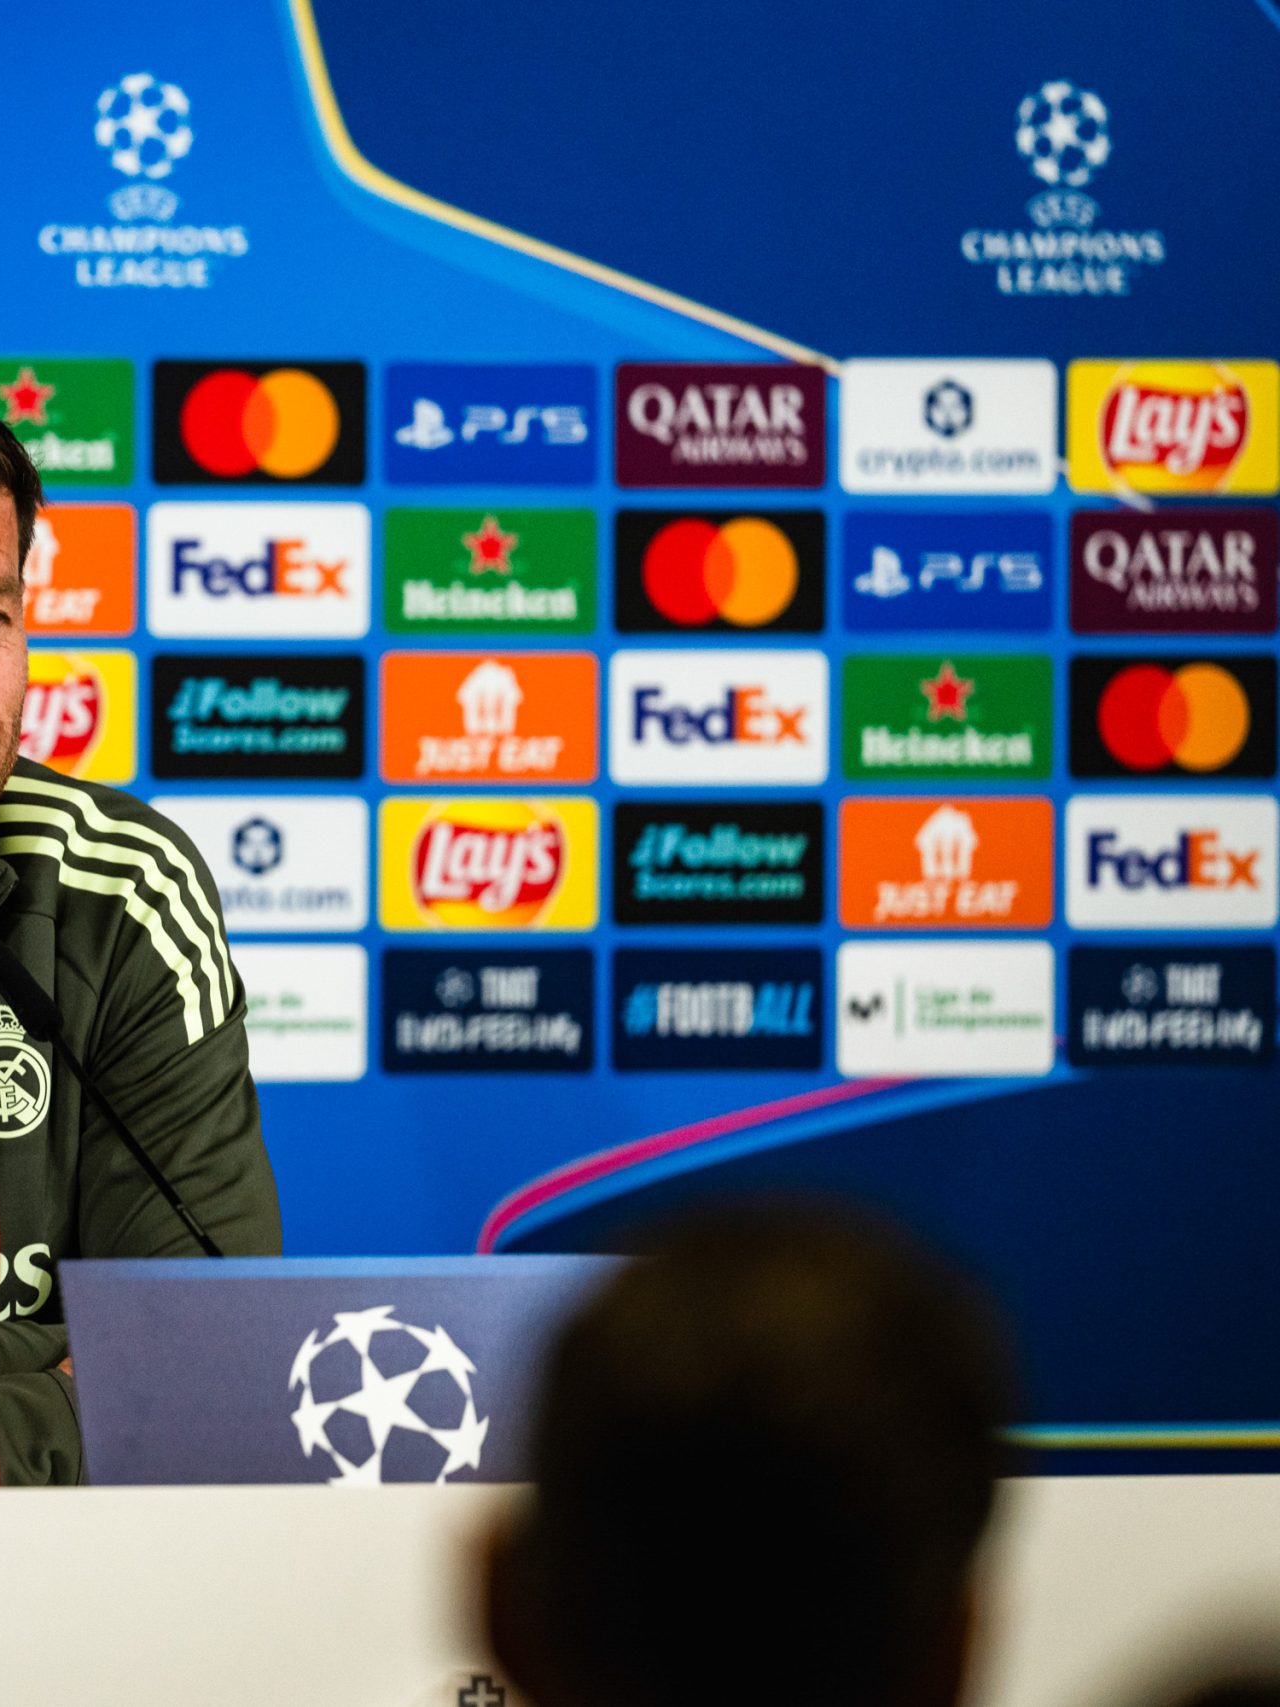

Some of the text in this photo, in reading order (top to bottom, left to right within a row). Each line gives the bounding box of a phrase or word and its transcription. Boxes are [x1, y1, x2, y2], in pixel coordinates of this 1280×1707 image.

[39, 225, 248, 256] CHAMPIONS
[962, 231, 1165, 264] CHAMPIONS
[76, 257, 208, 287] LEAGUE
[998, 262, 1125, 293] LEAGUE
[461, 406, 587, 443] PS5
[627, 384, 804, 444] QATAR
[1110, 381, 1242, 474] Lay's
[171, 539, 347, 598] FedEx
[919, 554, 1042, 590] PS5
[1083, 530, 1254, 590] QATAR
[33, 588, 101, 624] EAT
[403, 580, 577, 619] Heineken
[632, 687, 807, 745] FedEx
[417, 737, 562, 775] JUST EAT
[861, 727, 1032, 766] Heineken
[422, 822, 560, 912] Lay's
[1087, 831, 1260, 890] FedEx
[874, 882, 1018, 923] JUST EAT
[622, 981, 815, 1037] #FOOTBALL
